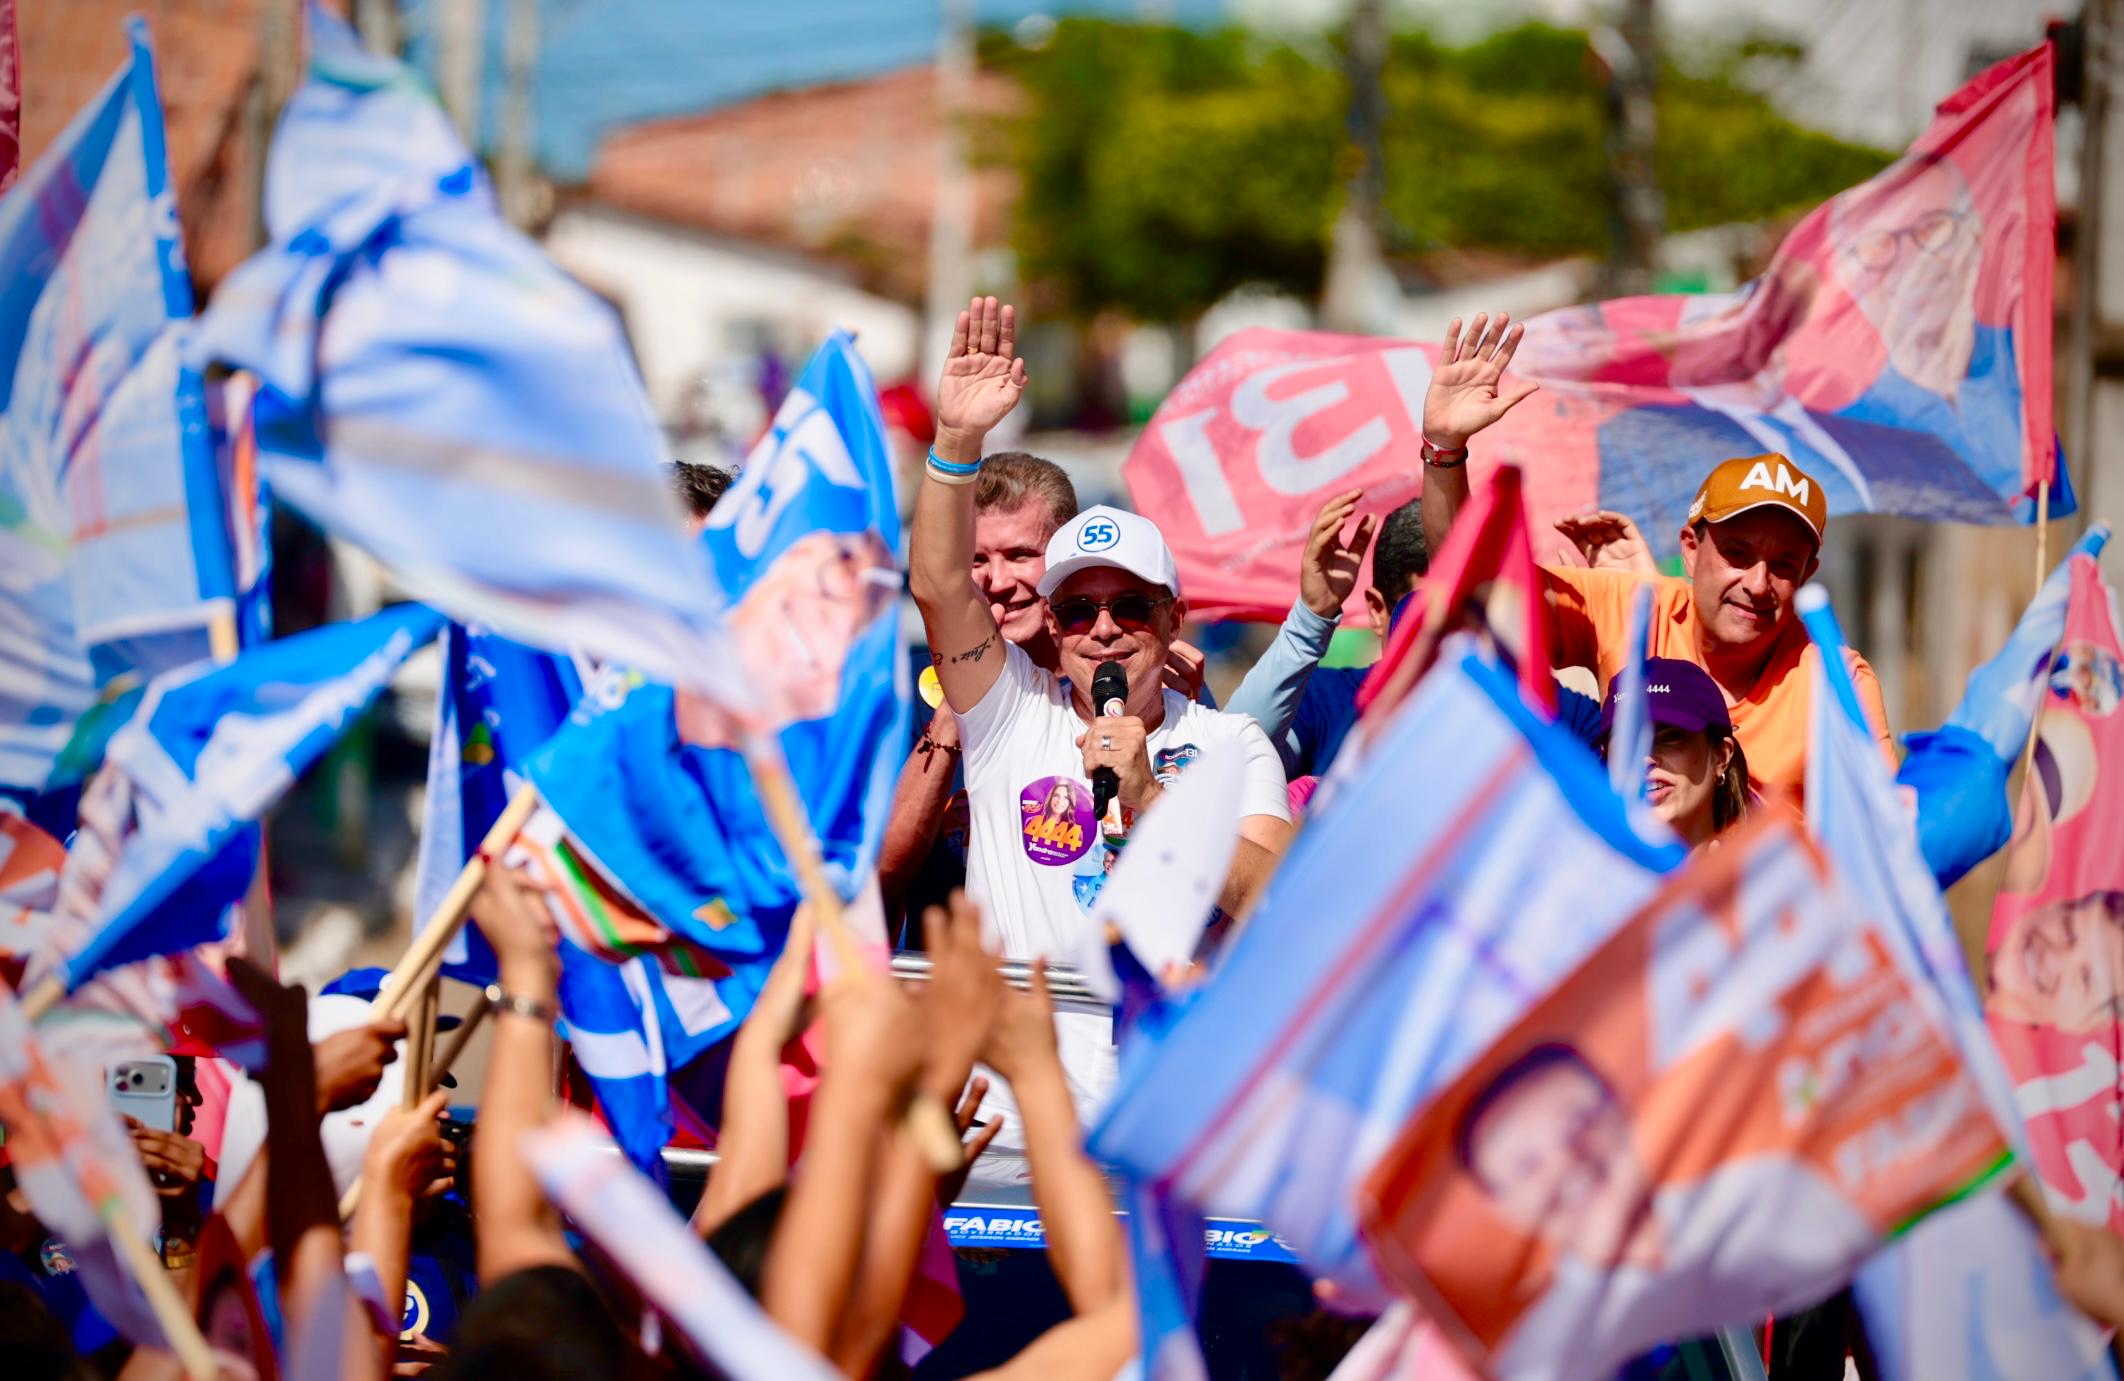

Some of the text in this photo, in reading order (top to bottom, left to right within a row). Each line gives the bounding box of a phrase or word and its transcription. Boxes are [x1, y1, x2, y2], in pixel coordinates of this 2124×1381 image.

[1739, 461, 1809, 507] AM
[1083, 525, 1113, 545] 55
[1646, 684, 1671, 694] 4444
[1024, 815, 1083, 852] 4444
[1205, 1229, 1268, 1245] BIO
